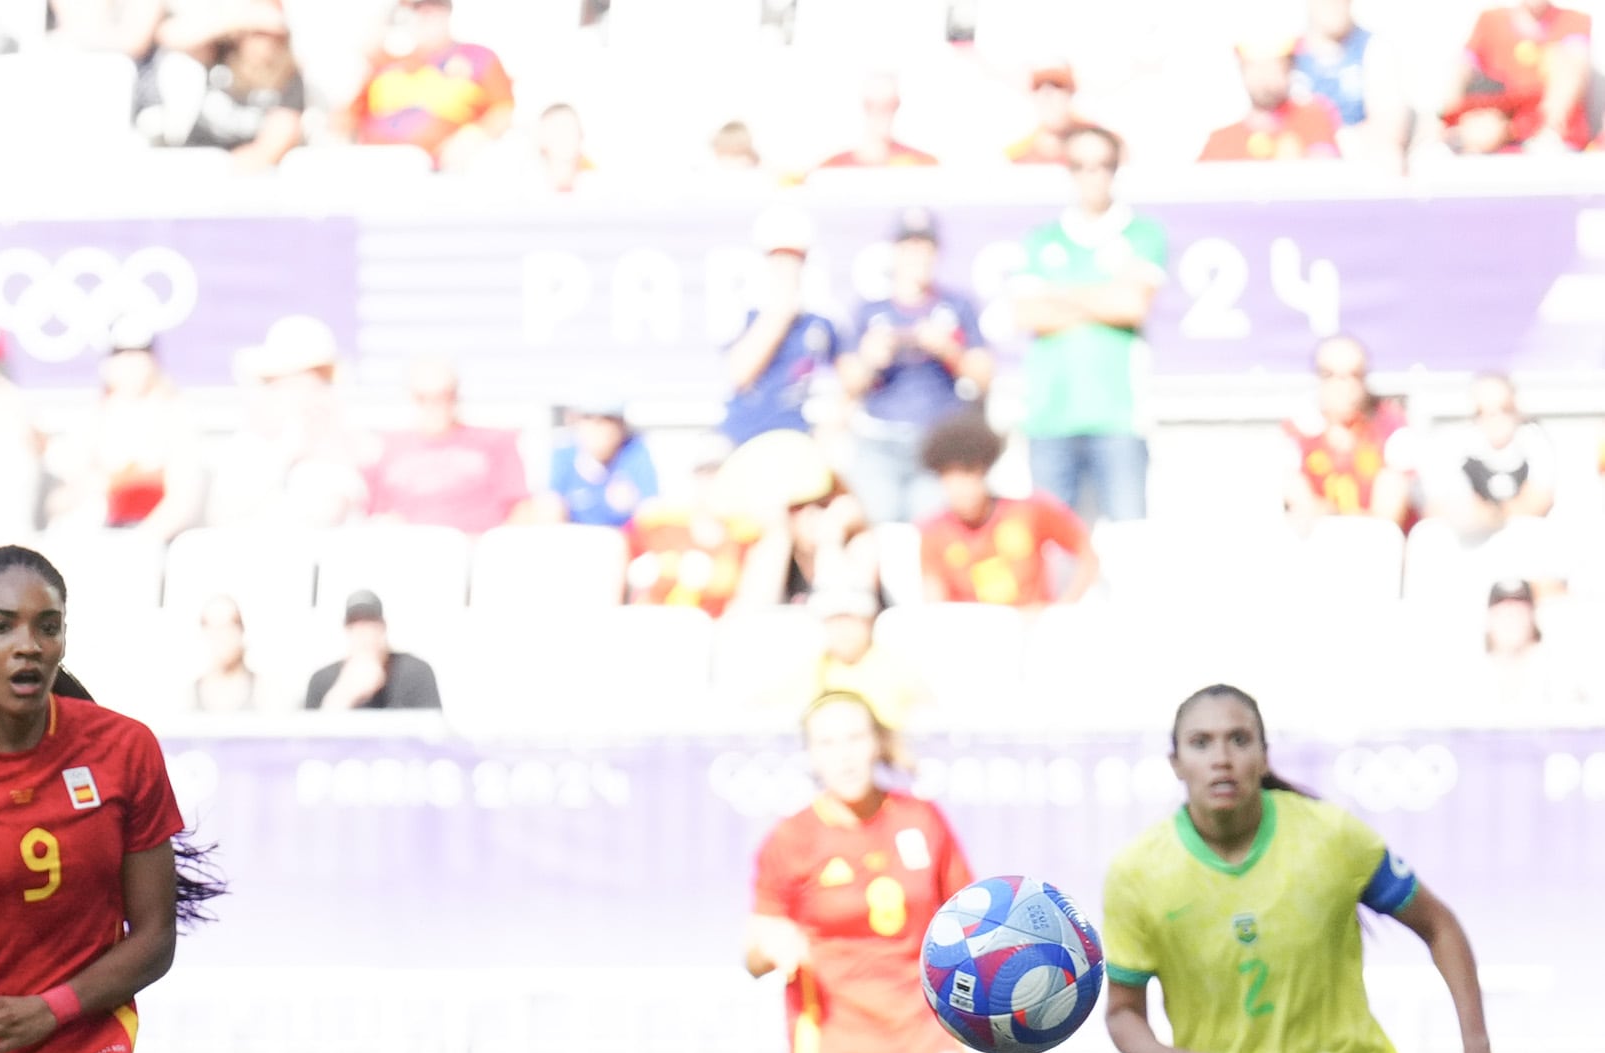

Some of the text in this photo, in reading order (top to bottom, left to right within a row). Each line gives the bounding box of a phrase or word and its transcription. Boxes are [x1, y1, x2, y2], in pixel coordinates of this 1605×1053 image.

[296, 758, 631, 809] PARIS 2024
[19, 827, 62, 902] 9
[865, 876, 906, 937] 8
[1238, 958, 1275, 1018] 2
